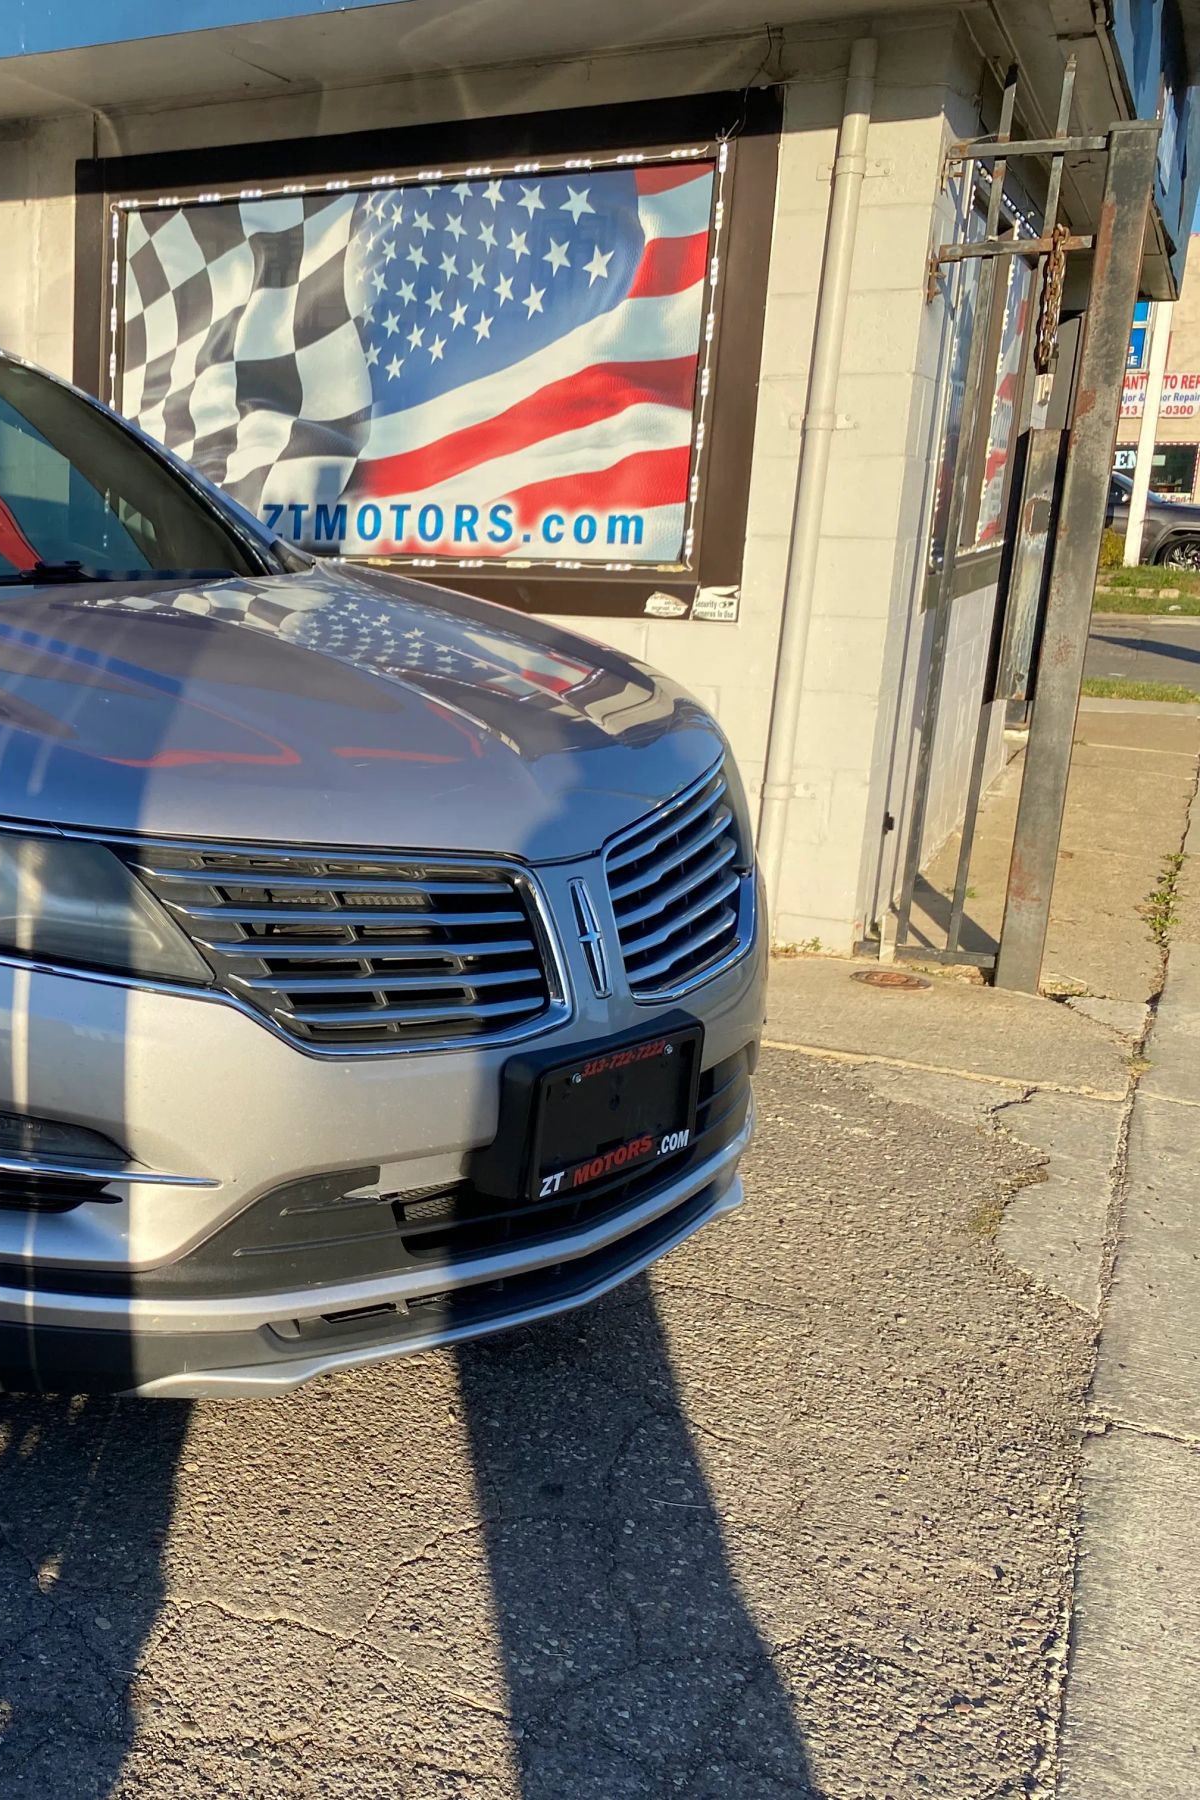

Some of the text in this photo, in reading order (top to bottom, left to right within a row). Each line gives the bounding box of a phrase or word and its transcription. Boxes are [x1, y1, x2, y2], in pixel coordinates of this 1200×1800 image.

[1122, 375, 1148, 390] ANT
[1161, 405, 1194, 415] -0300
[1113, 450, 1138, 469] EN
[262, 503, 645, 545] ZTMOTORS.com
[539, 1129, 690, 1198] ZT MOTORS .COM
